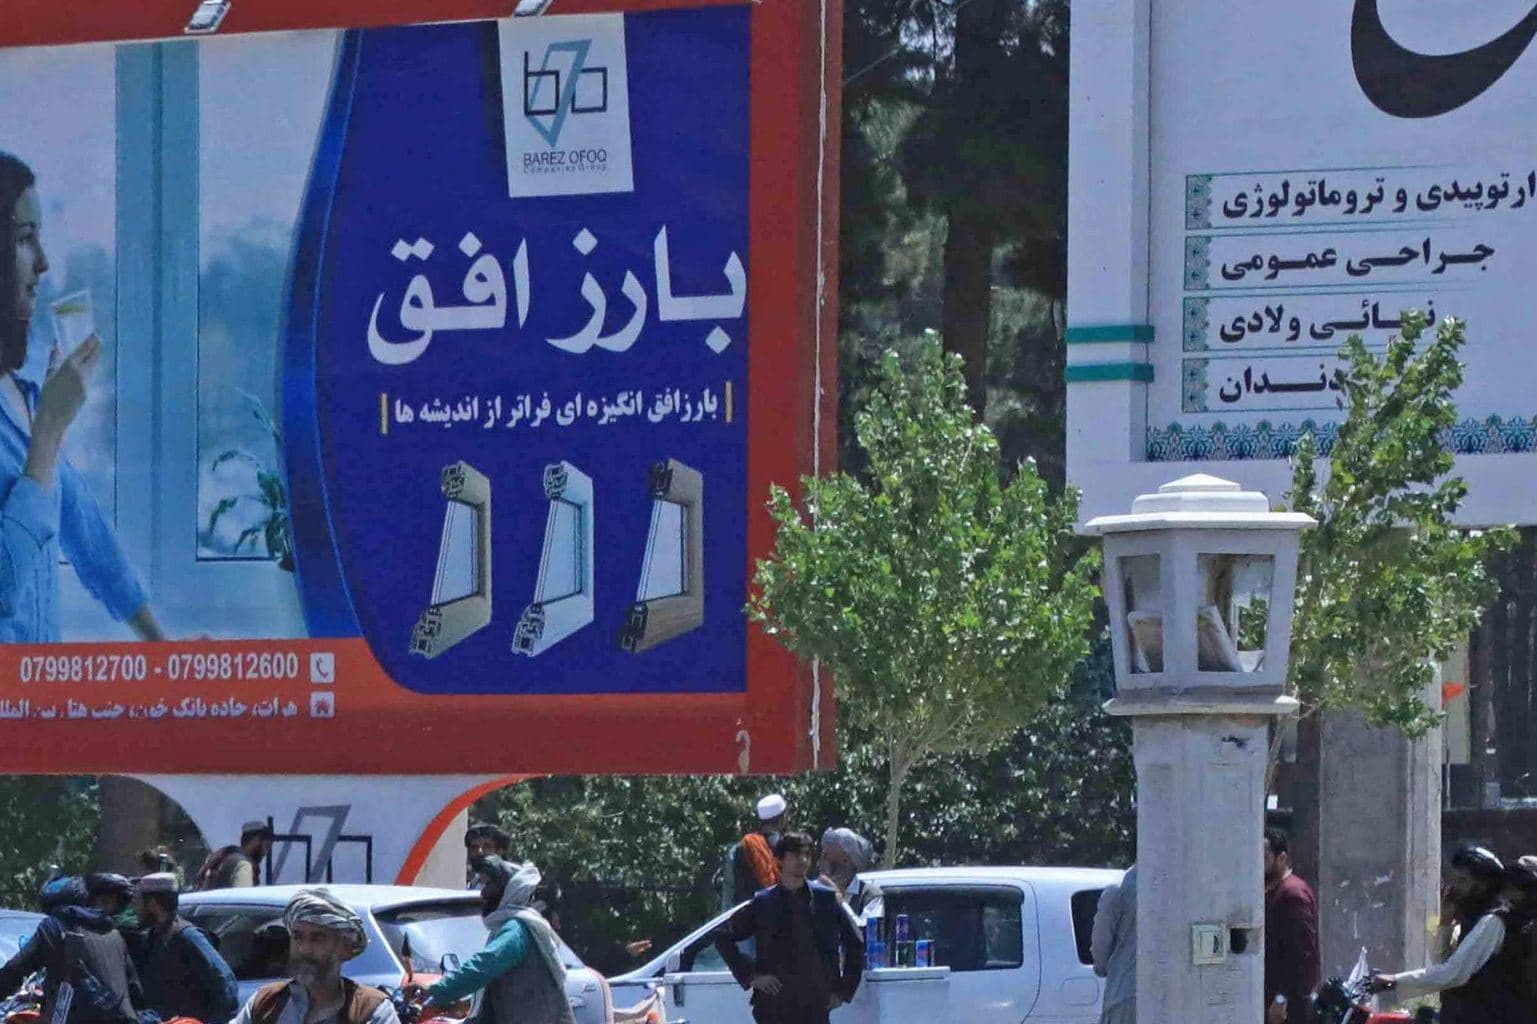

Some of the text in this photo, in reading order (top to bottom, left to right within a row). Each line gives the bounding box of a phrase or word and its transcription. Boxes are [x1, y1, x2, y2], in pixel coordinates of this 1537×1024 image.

[523, 148, 607, 166] BAREZ OFOQ
[1223, 177, 1385, 218] تروماتولوژی
[1392, 188, 1408, 213] و
[1221, 237, 1495, 280] جراحی عمومی
[367, 224, 747, 365] بارز افق
[394, 398, 414, 423] ها
[419, 395, 479, 428] اندیشه
[483, 394, 502, 429] از
[505, 391, 552, 428] فراتر
[556, 391, 582, 426] ای
[587, 389, 643, 425] انگیزه
[20, 654, 148, 682] 0799812700
[168, 653, 298, 680] 0799812600
